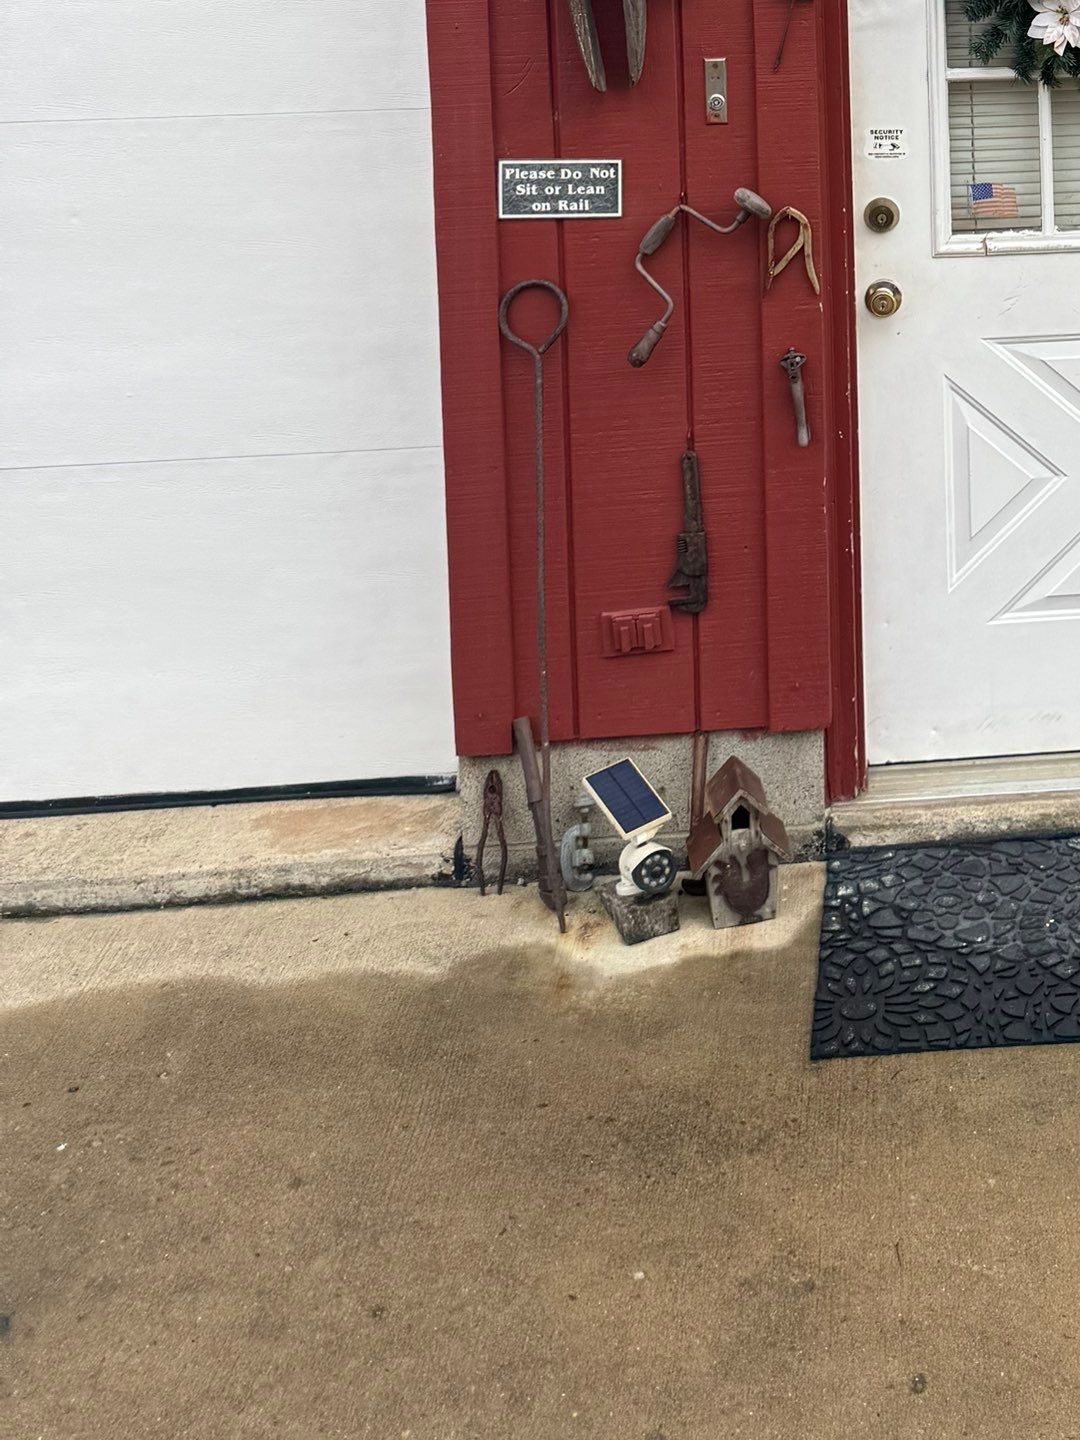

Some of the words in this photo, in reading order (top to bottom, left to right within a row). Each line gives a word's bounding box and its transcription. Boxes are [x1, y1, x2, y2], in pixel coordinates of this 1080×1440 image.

[504, 168, 556, 180] Please
[560, 168, 582, 179] Do
[590, 167, 616, 179] Not
[515, 183, 538, 195] Sit
[544, 186, 561, 195] or
[567, 184, 605, 195] Lean
[532, 201, 551, 211] on
[558, 199, 590, 211] Rail
